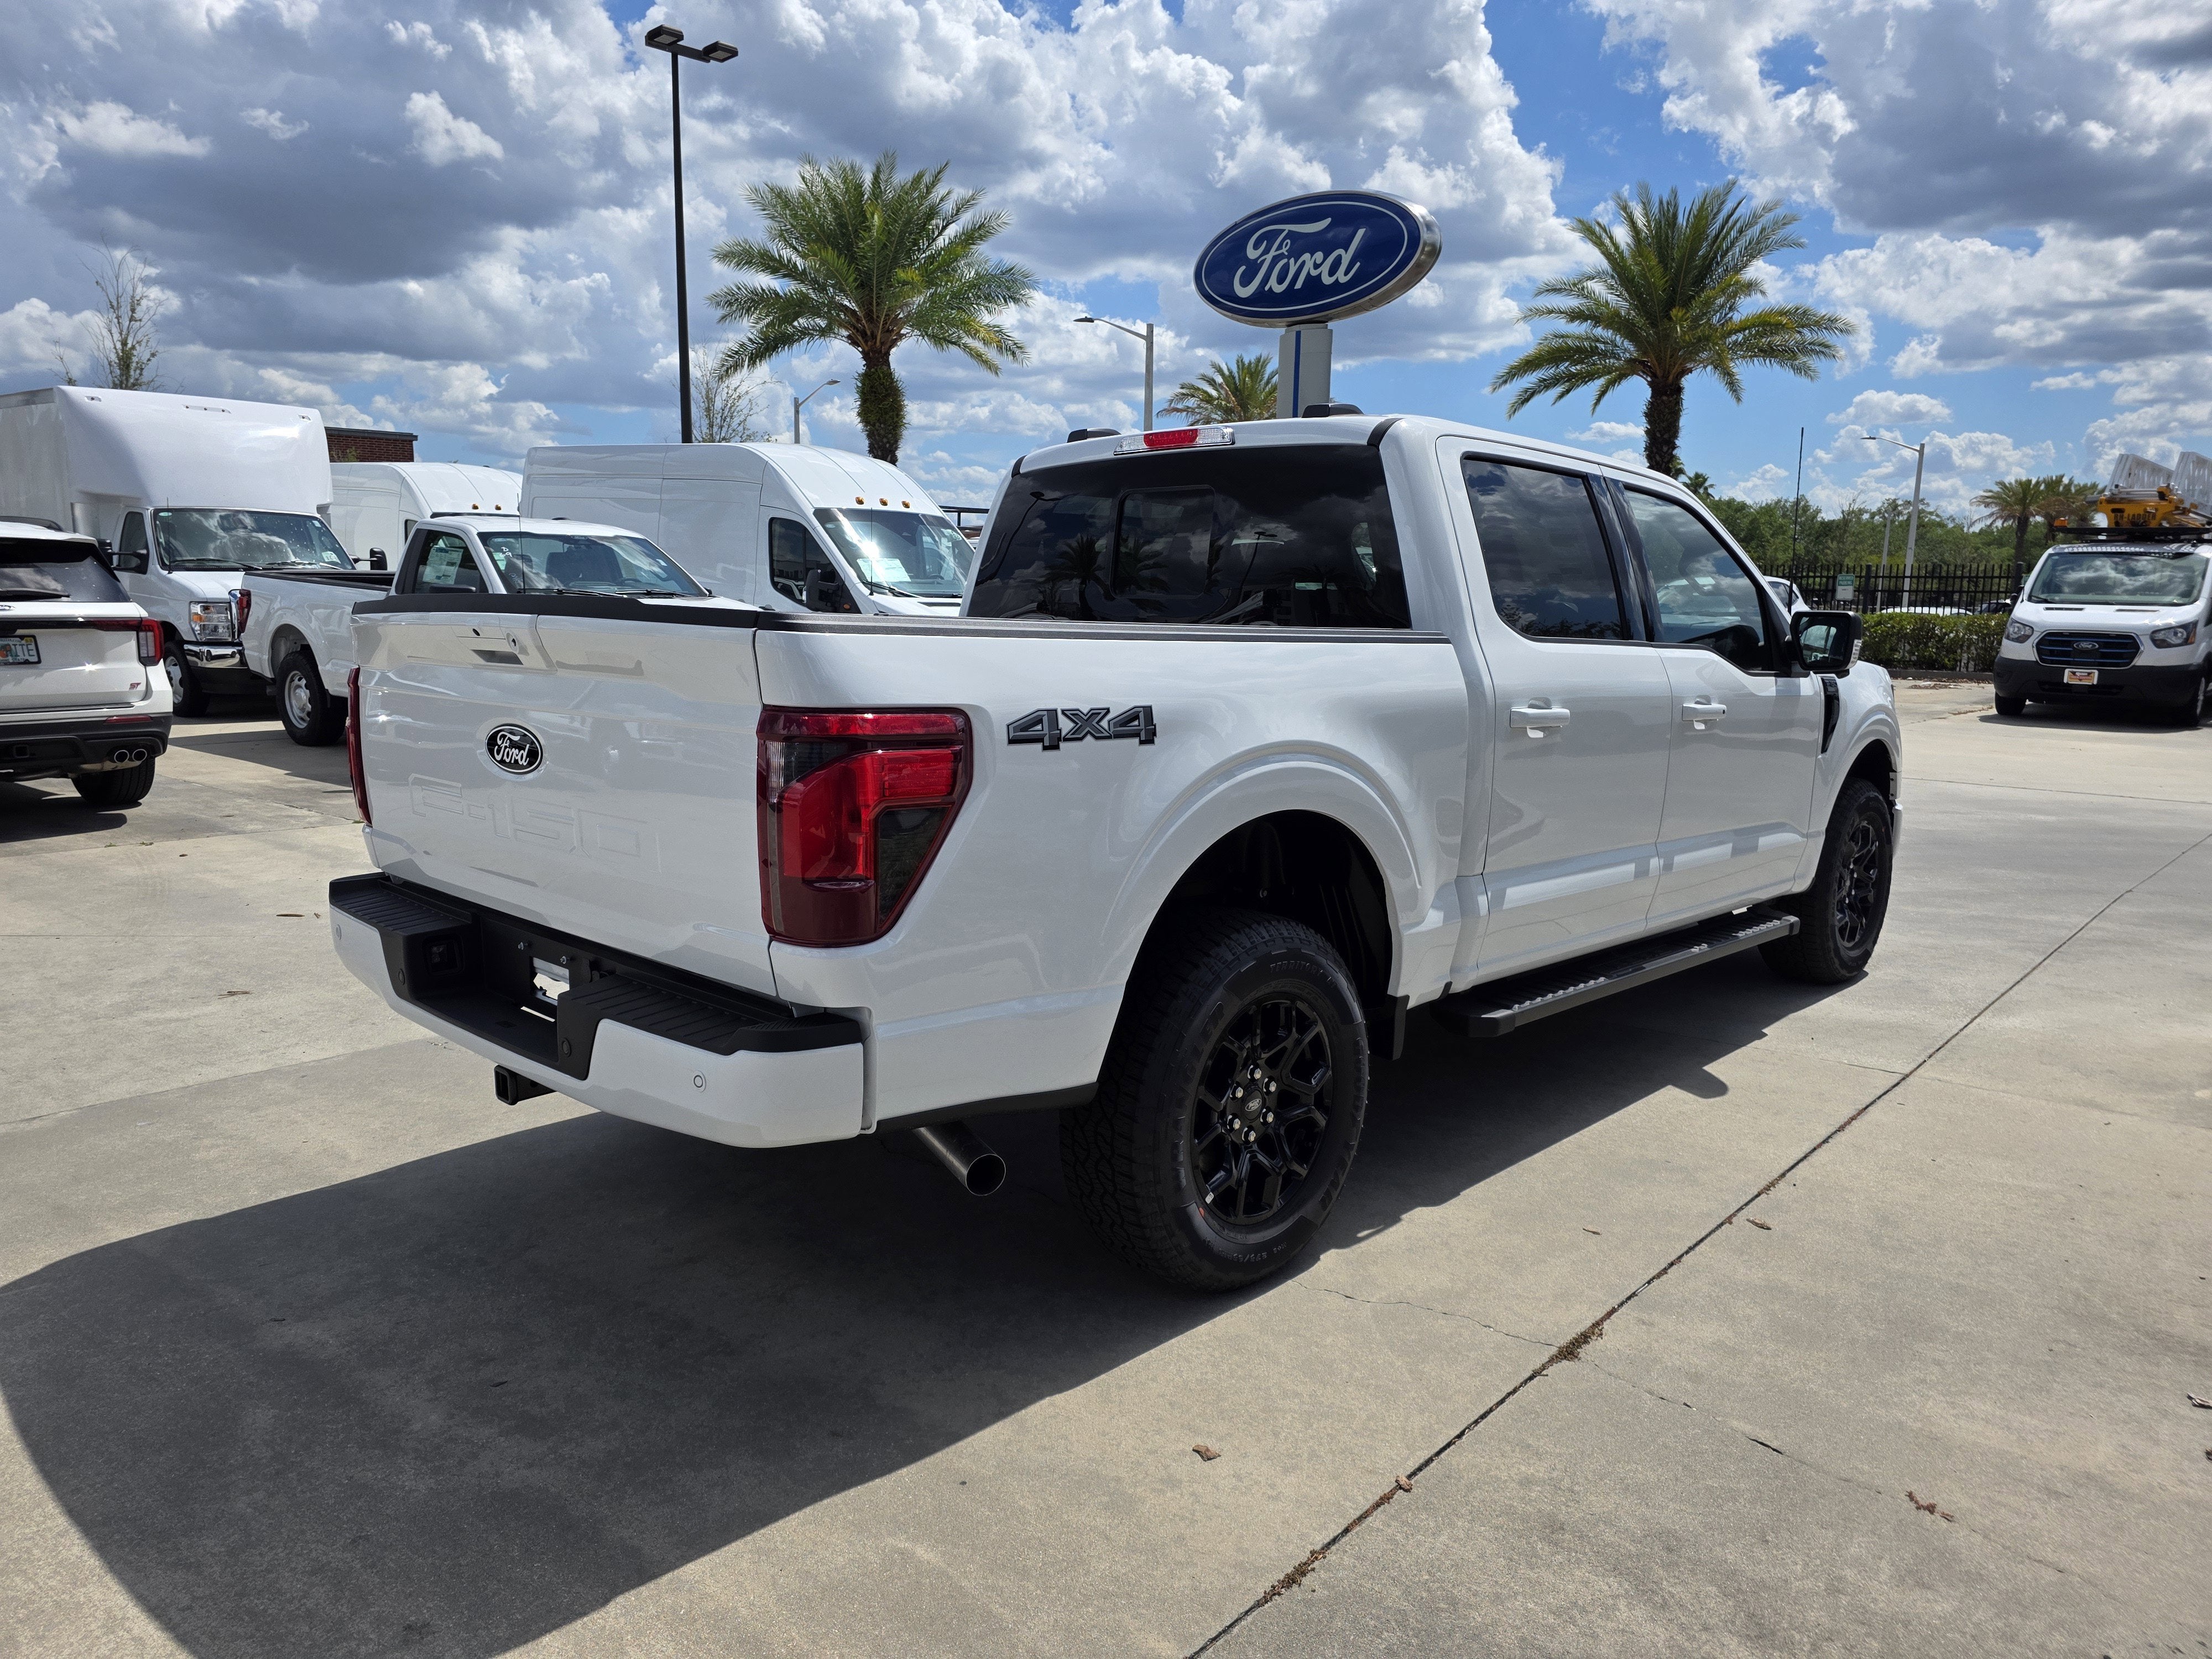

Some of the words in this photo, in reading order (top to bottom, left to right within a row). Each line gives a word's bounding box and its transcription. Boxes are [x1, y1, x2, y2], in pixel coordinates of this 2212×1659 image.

[1233, 217, 1367, 298] Ford
[494, 732, 529, 766] Ford
[409, 774, 661, 874] F-150
[1270, 961, 1323, 976] TERRITORY
